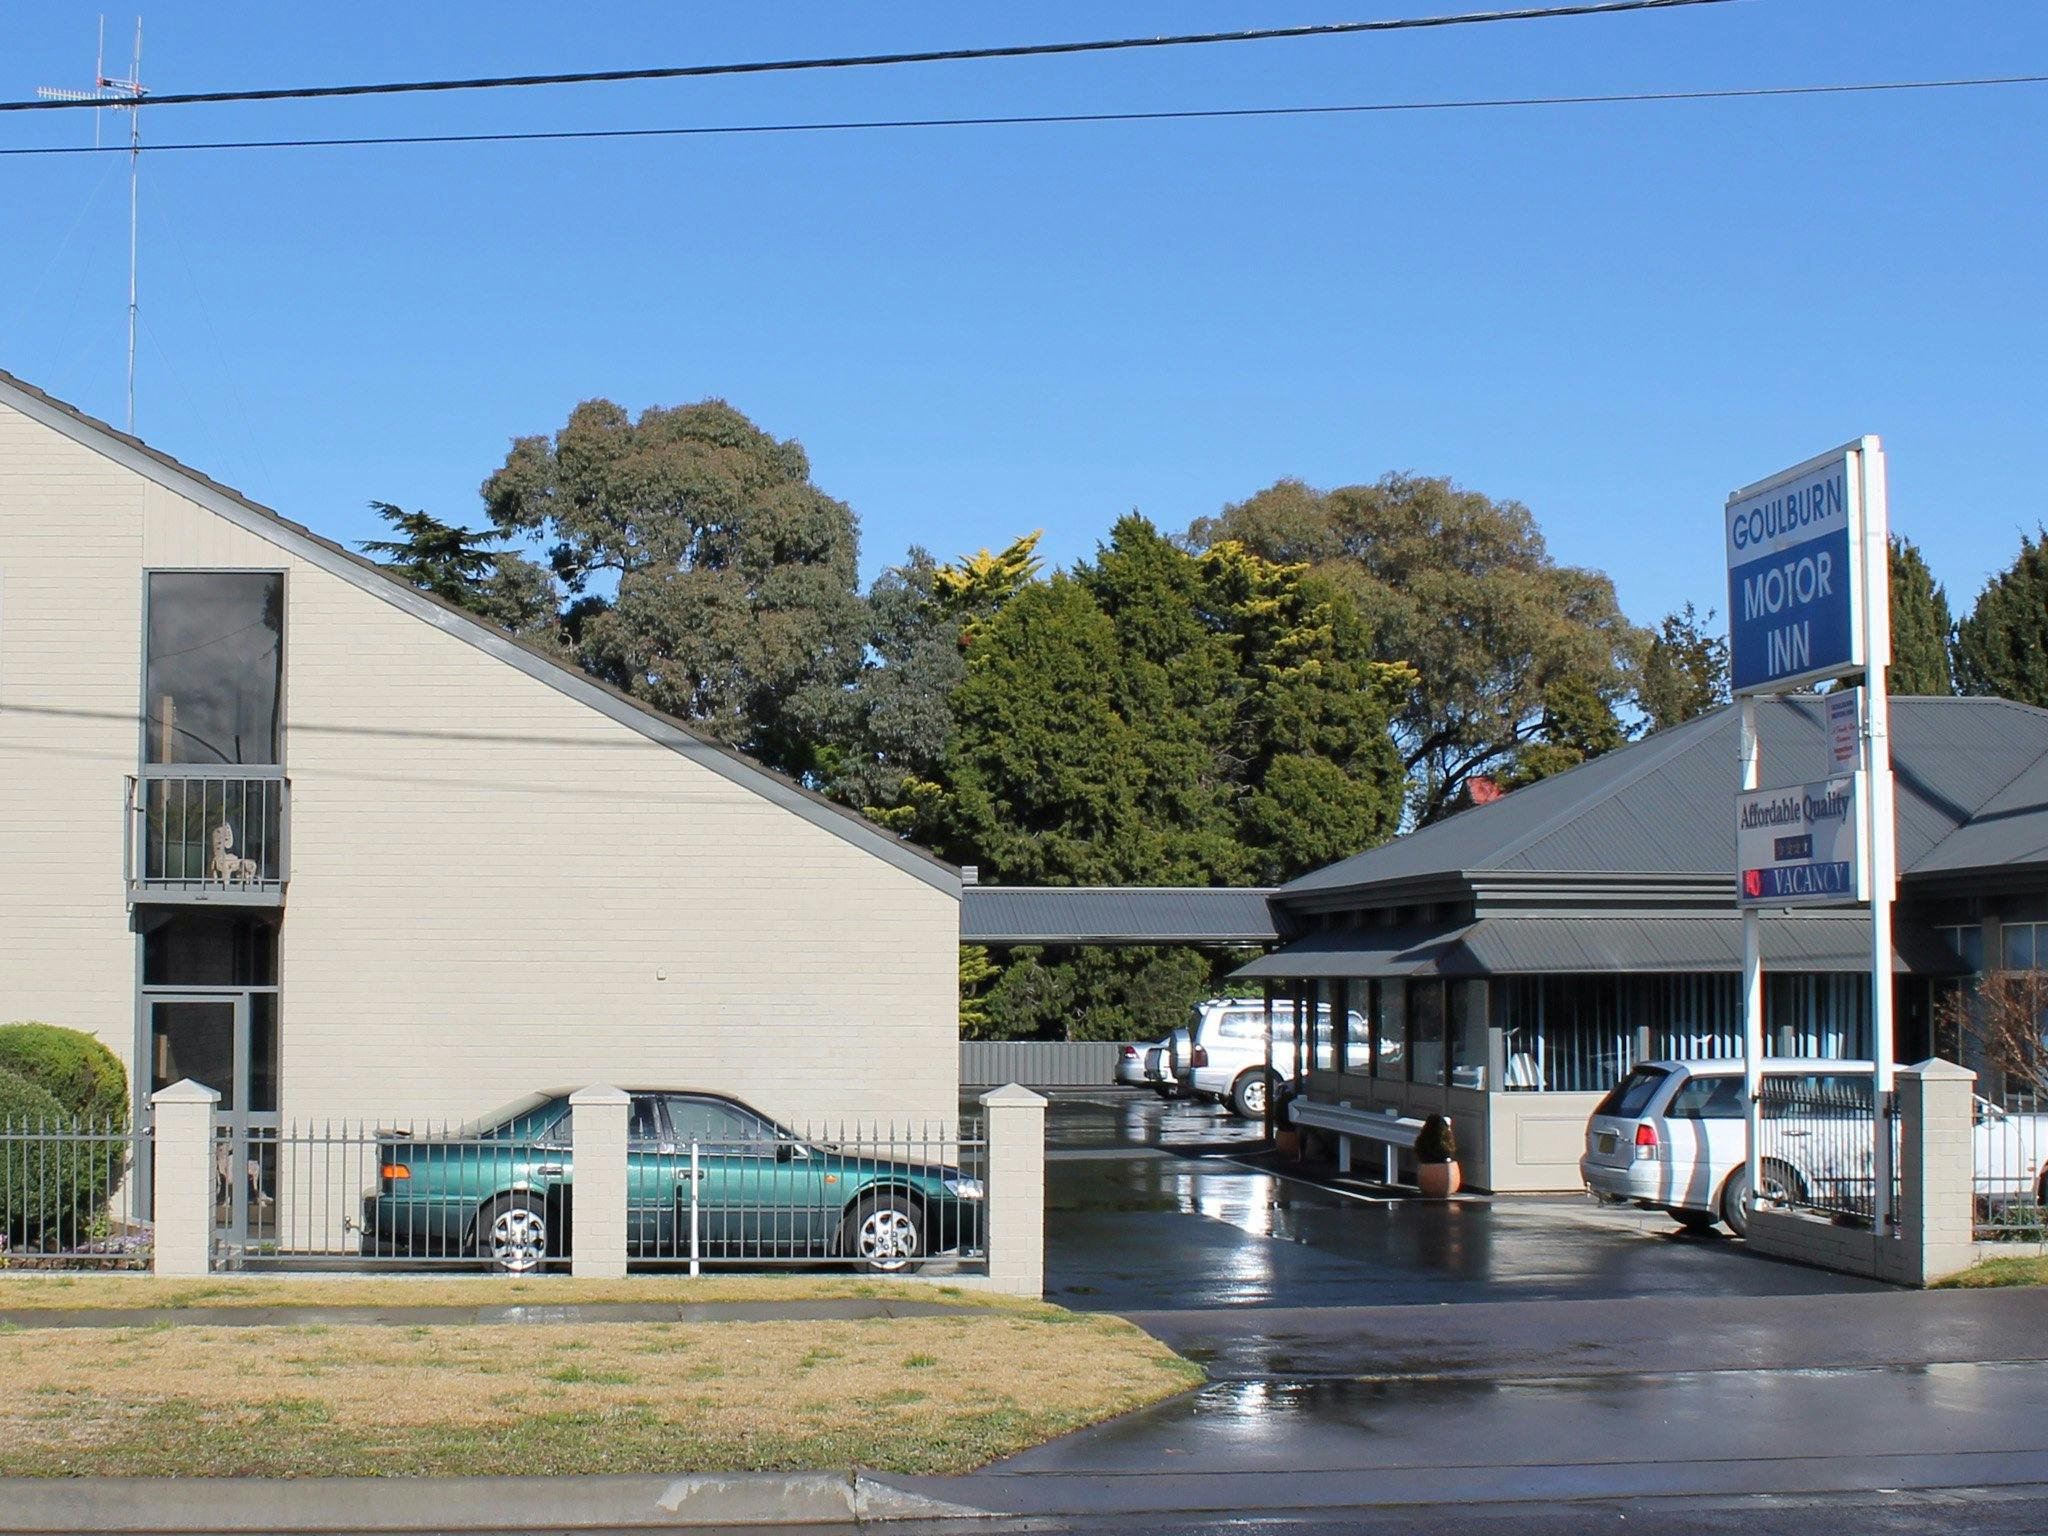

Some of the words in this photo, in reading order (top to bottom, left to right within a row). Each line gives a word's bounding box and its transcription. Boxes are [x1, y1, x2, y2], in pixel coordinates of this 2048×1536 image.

[1733, 476, 1841, 550] GOULBURN
[1744, 551, 1832, 620] MOTOR
[1768, 621, 1809, 676] INN
[1741, 797, 1800, 830] Affordable
[1803, 792, 1849, 825] Quality
[1774, 864, 1843, 894] VACANCY
